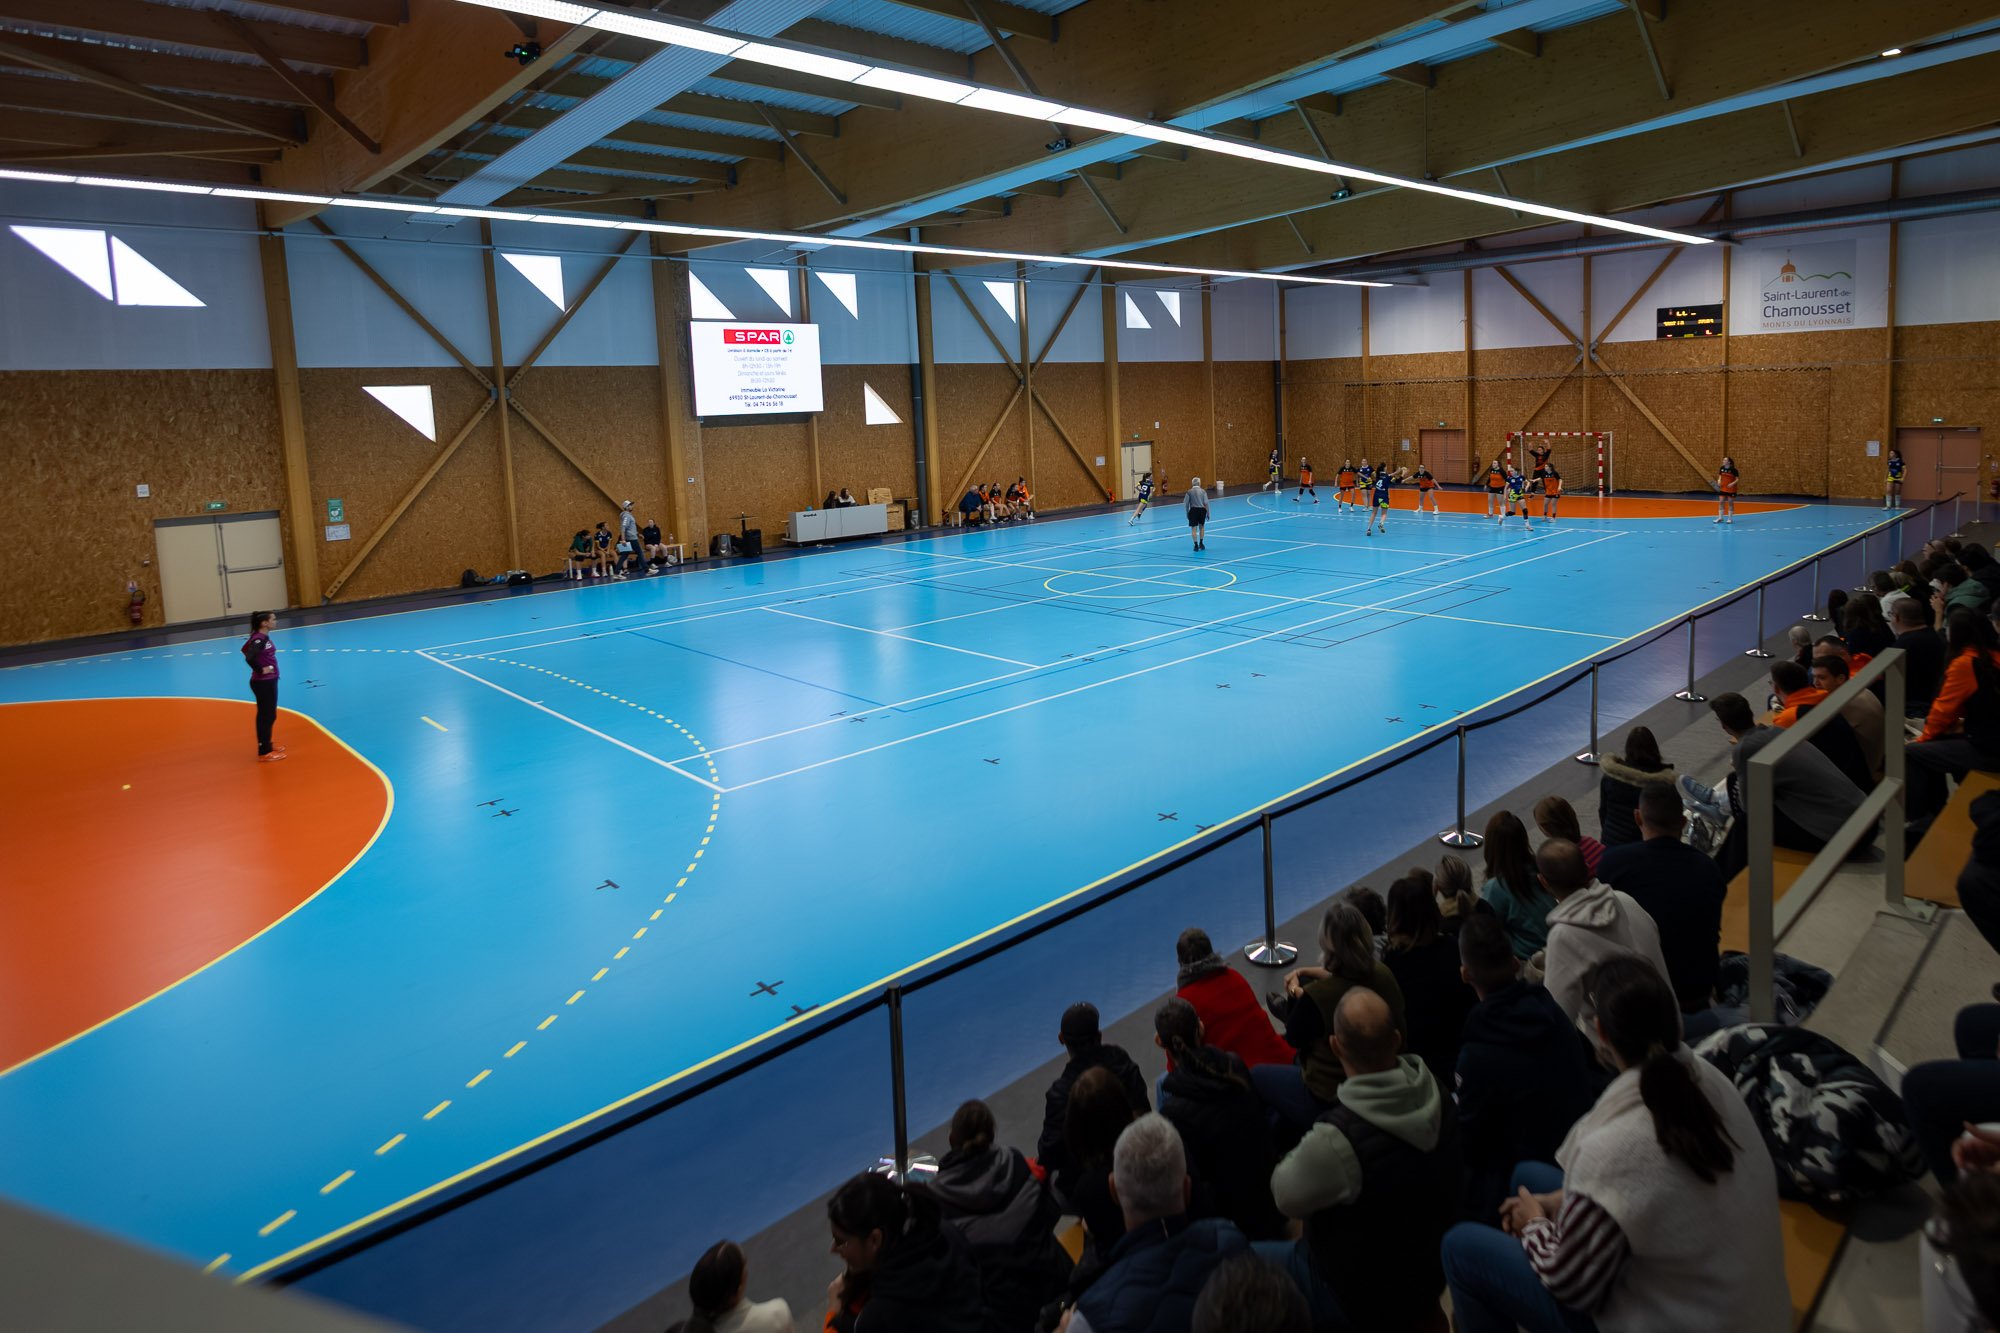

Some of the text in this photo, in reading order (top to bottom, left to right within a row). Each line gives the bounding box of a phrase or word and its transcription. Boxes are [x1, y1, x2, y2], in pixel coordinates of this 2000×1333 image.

[1763, 301, 1851, 318] Chamousset
[1762, 317, 1851, 329] MONTS DU LYONNAIS
[735, 331, 780, 342] SPAR
